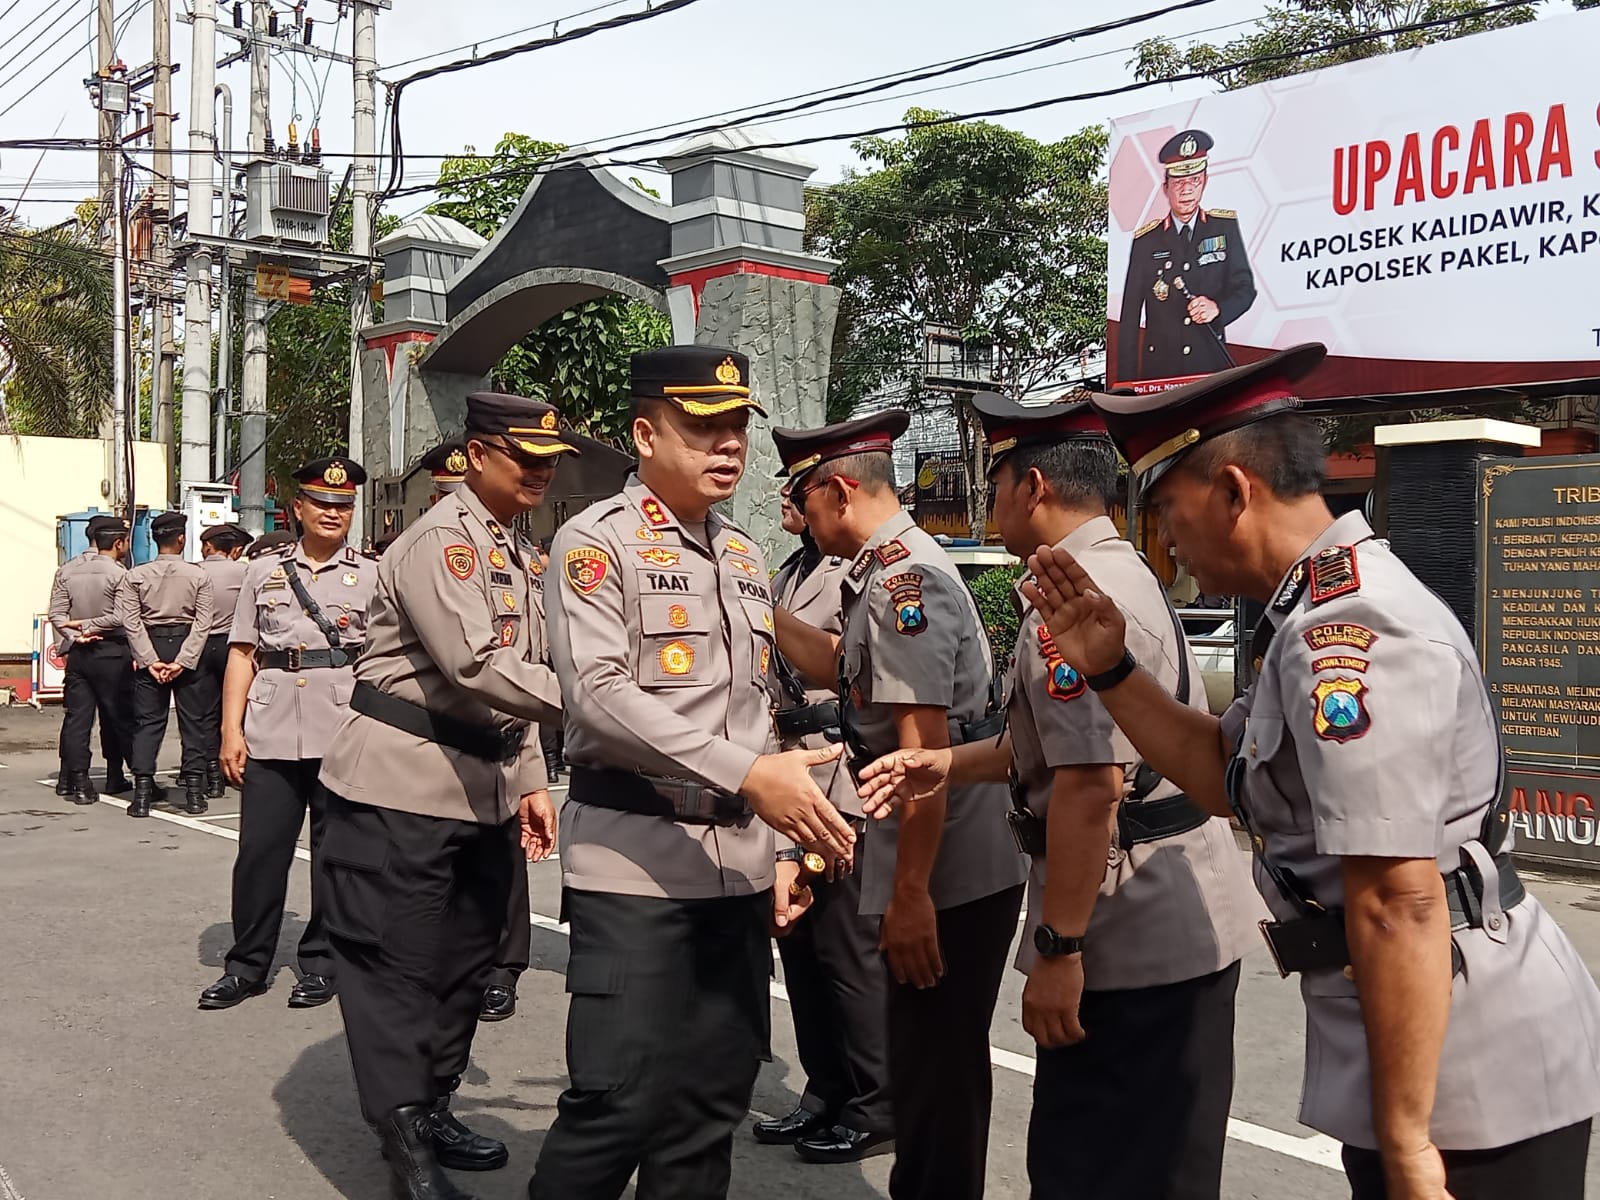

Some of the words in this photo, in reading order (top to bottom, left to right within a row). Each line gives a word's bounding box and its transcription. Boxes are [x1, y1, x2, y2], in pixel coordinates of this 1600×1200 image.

[1332, 103, 1573, 216] UPACARA
[1280, 225, 1404, 263] KAPOLSEK
[1411, 200, 1573, 243] KALIDAWIR,
[1306, 253, 1433, 290] KAPOLSEK
[1440, 241, 1530, 273] PAKEL,
[1495, 518, 1520, 528] KAMI
[1521, 517, 1554, 527] POLISI
[1503, 534, 1556, 545] BERBAKTI
[1503, 548, 1547, 558] DENGAN
[1550, 547, 1587, 557] PENUH
[1502, 561, 1539, 571] TUHAN
[1540, 561, 1570, 571] YANG
[646, 573, 690, 592] TAAT
[1502, 588, 1582, 598] MENJUNJUNG
[1502, 603, 1555, 613] KEADILAN
[1563, 603, 1586, 612] DAN
[1502, 616, 1572, 626] MENEGAKKAN
[1312, 625, 1371, 640] POLRES
[1502, 629, 1551, 640] REPUBLIK
[1502, 643, 1569, 654] PANCASILA
[1502, 657, 1536, 666] DASAR
[1538, 658, 1563, 668] 1945.
[1502, 684, 1560, 695] SENANTIASA
[1502, 697, 1547, 709] MELAYANI
[1502, 711, 1537, 722] UNTUK
[1502, 724, 1563, 737] KETERTIBAN.
